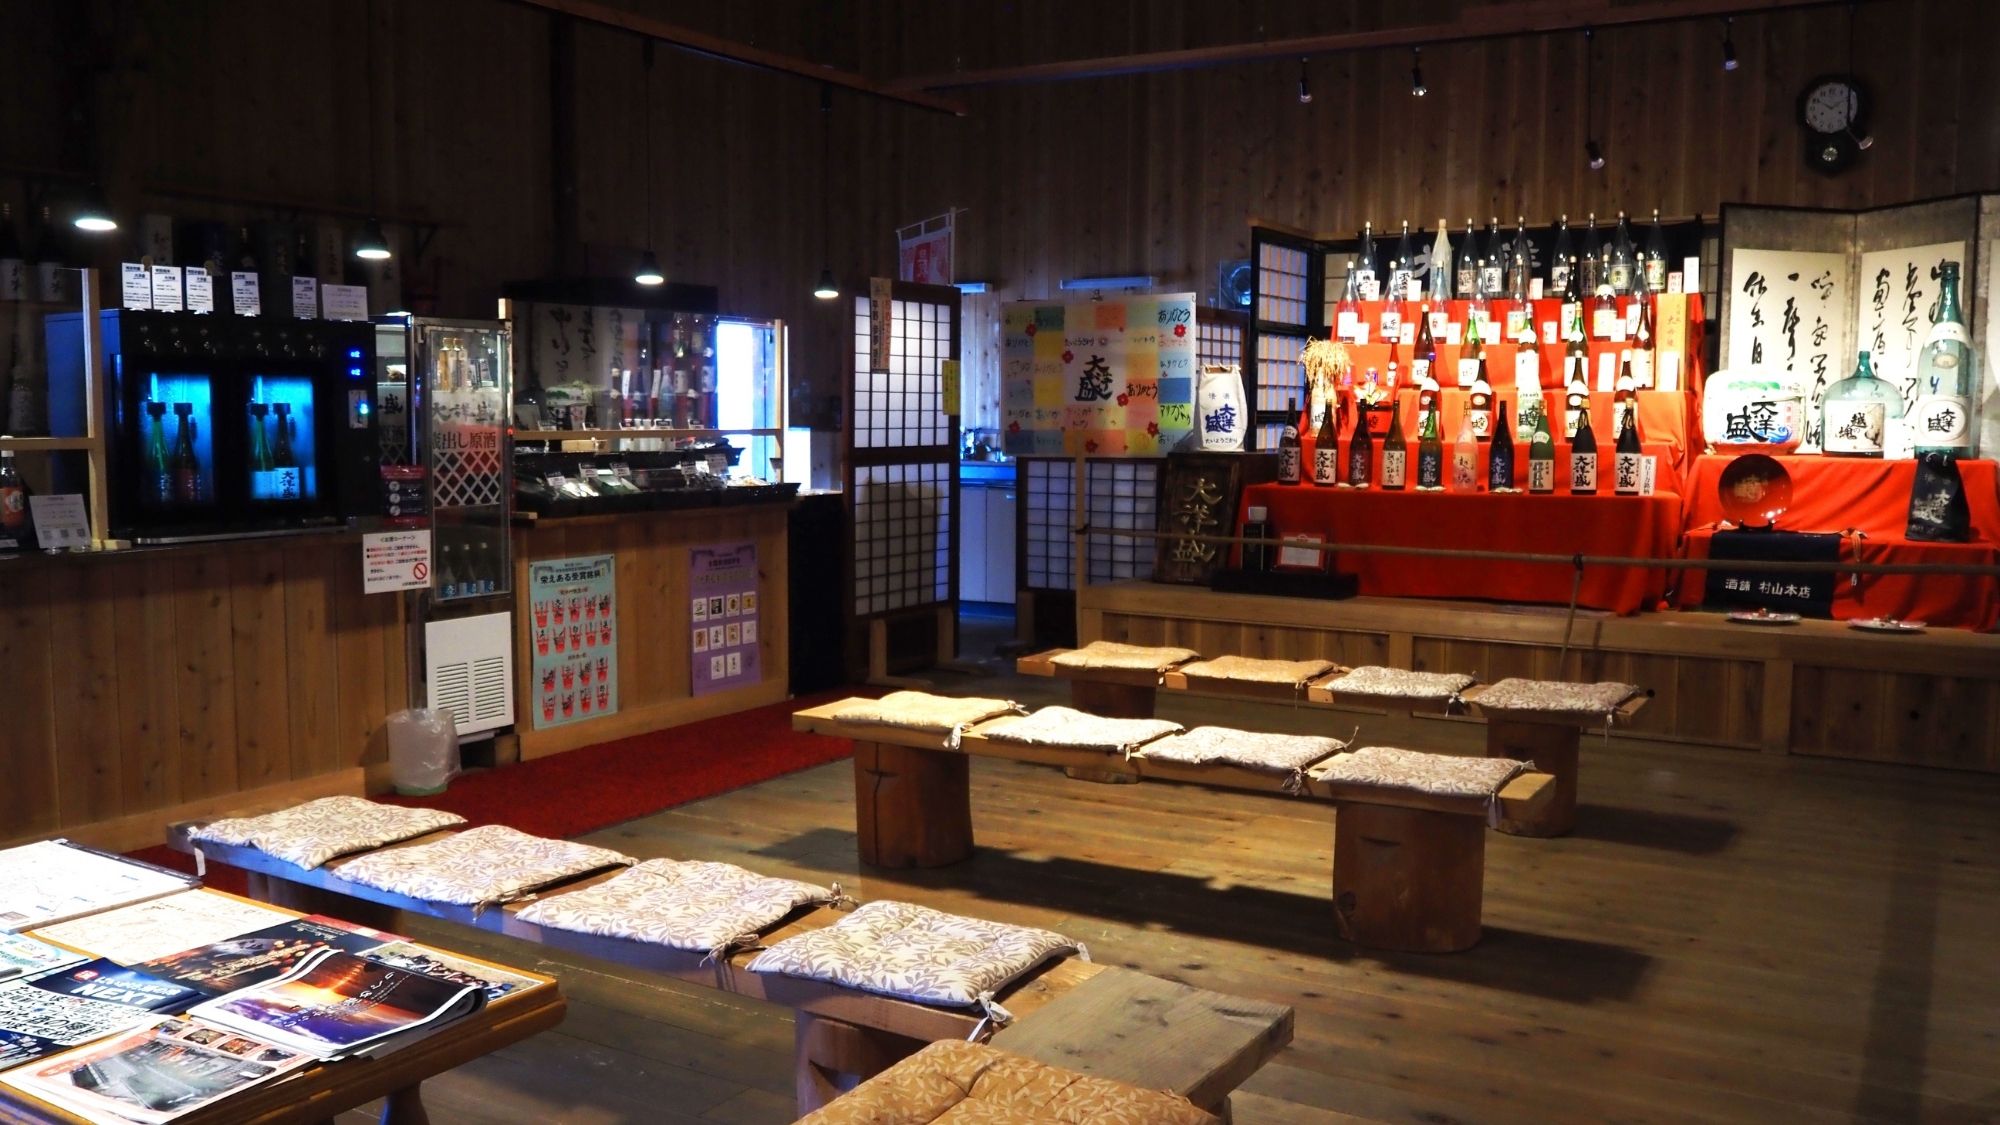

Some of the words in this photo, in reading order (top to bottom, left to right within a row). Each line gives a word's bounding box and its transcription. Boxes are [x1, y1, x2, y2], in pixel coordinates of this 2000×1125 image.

[1205, 403, 1237, 433] 大洋盛
[1726, 395, 1779, 442] 大洋盛
[1927, 408, 1957, 432] 大洋盛
[1279, 448, 1295, 480] 大洋盛
[1316, 451, 1330, 481] 大洋盛
[1422, 455, 1436, 483] 大洋盛
[1573, 455, 1591, 487] 大洋盛
[1617, 455, 1636, 488] 大洋盛
[1759, 580, 1812, 599] 村山本店
[70, 983, 165, 1007] NEXT
